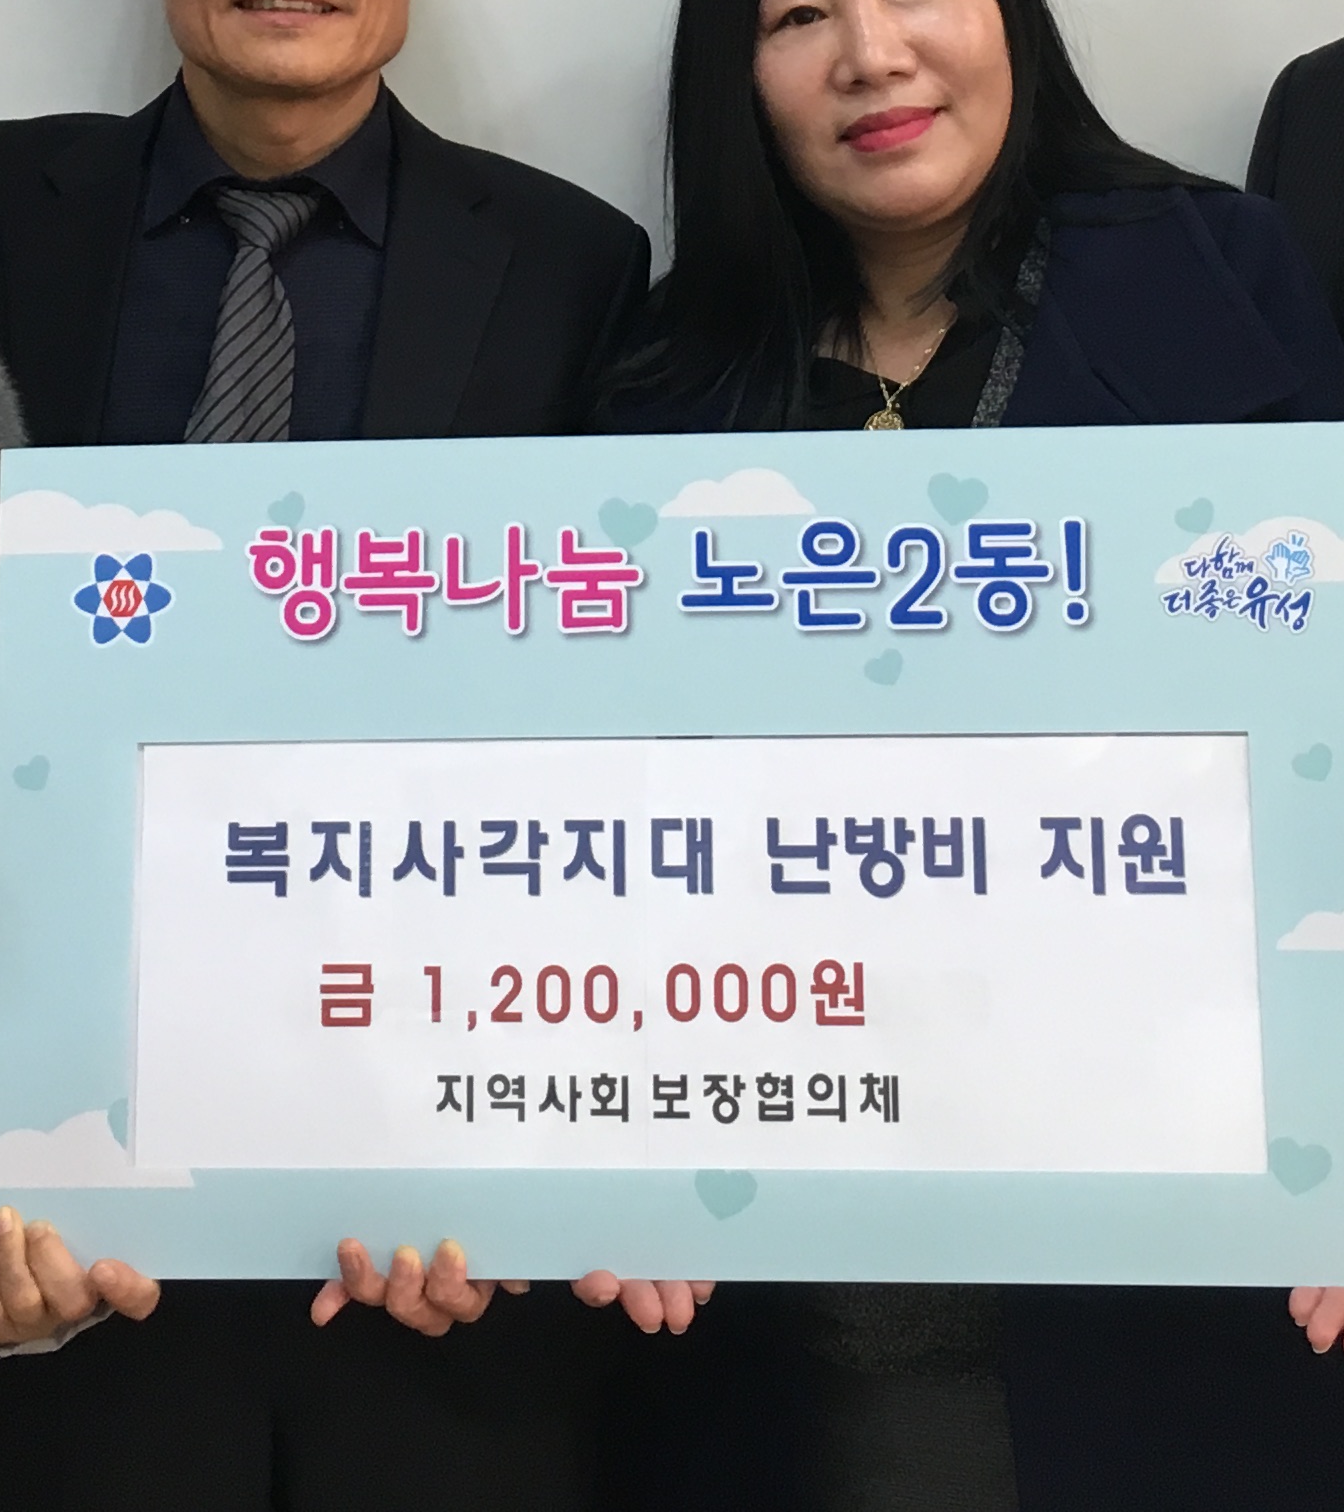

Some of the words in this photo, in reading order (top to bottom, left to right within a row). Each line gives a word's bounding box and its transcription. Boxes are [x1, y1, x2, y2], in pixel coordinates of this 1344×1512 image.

[248, 524, 641, 637] 행복나눔
[679, 520, 1088, 628] 노은2동!
[1183, 535, 1255, 580] 다함께
[224, 817, 714, 898] 복지사각지대
[765, 815, 989, 899] 난방비
[1039, 813, 1188, 896] 지원
[319, 963, 375, 1028] 금
[422, 958, 866, 1033] 1,200,000원
